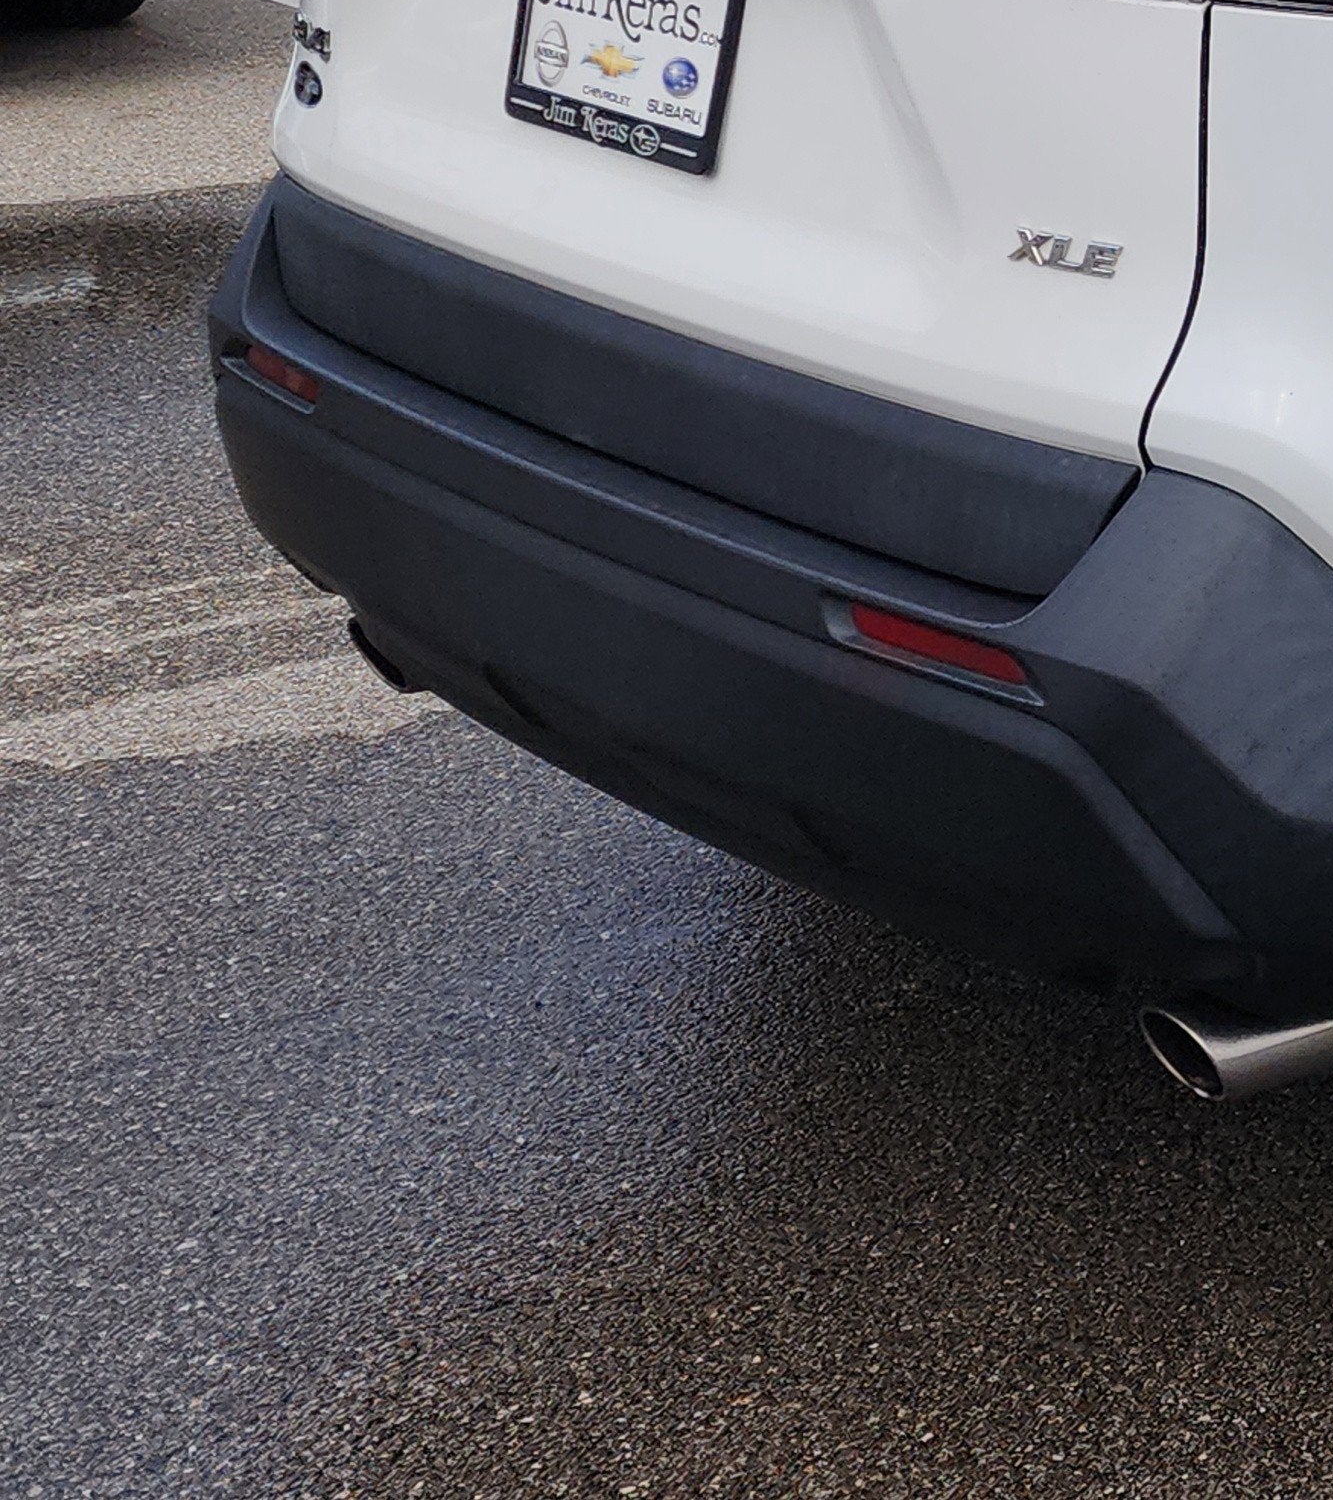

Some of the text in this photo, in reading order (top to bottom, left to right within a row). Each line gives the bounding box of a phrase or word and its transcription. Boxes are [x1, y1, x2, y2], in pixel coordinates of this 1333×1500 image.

[543, 96, 630, 144] Jim Keras
[647, 98, 703, 127] SUBARU
[1007, 226, 1124, 279] XLE
